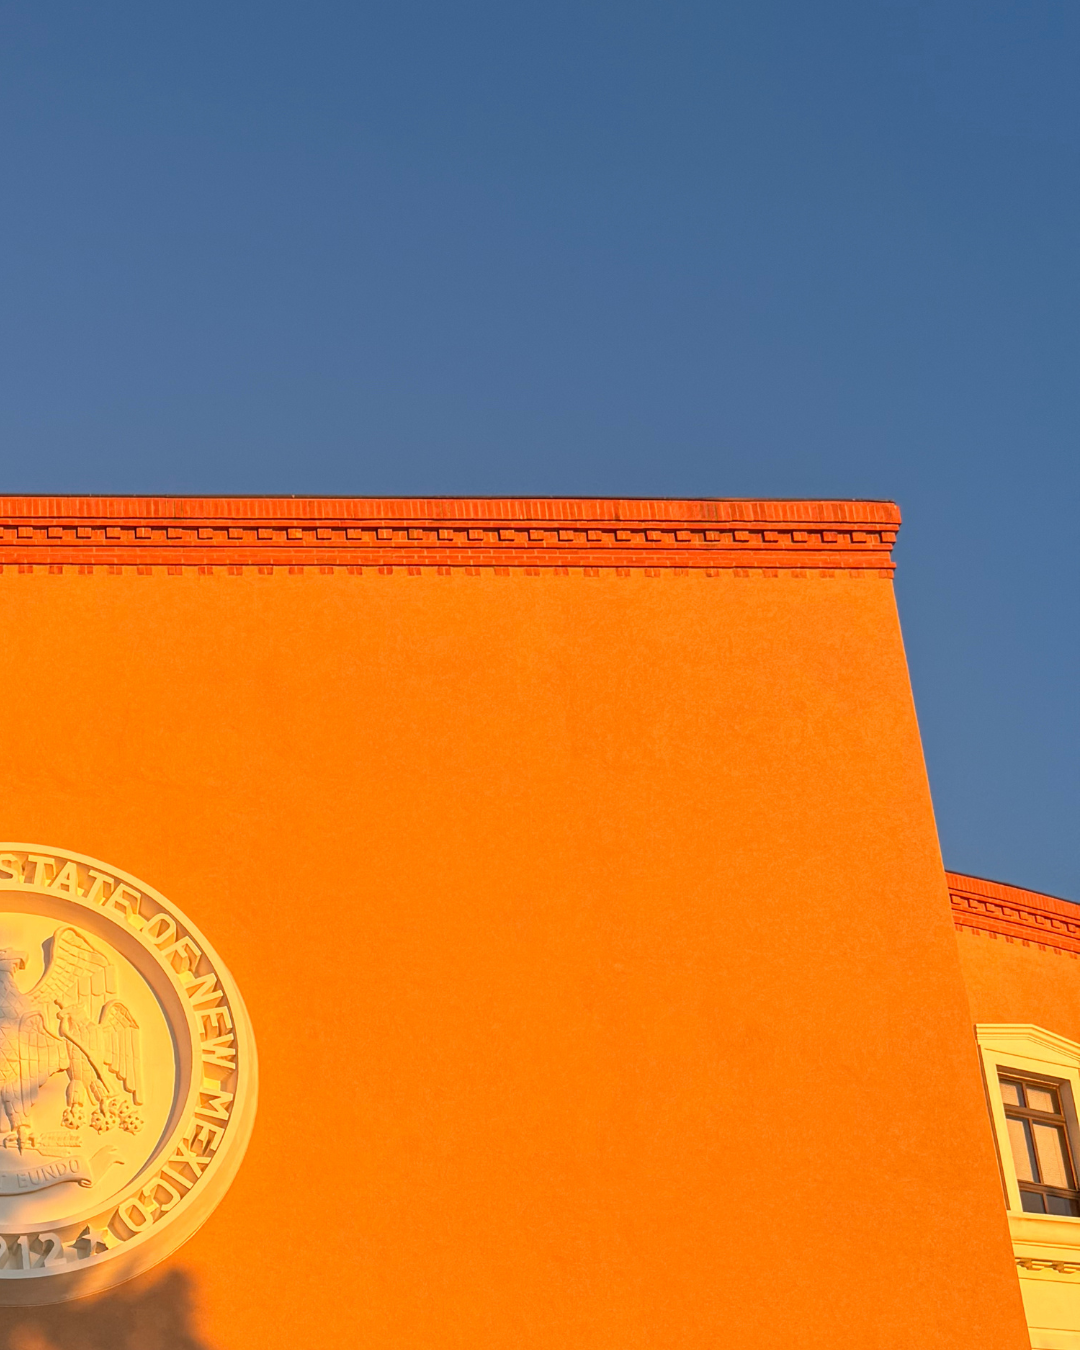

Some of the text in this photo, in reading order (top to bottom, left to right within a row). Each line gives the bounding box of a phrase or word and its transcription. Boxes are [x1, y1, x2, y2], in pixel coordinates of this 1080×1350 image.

[141, 913, 202, 963] OF
[185, 973, 236, 1070] NEW
[17, 1159, 80, 1189] EUNDO
[119, 1089, 234, 1232] MEXICO
